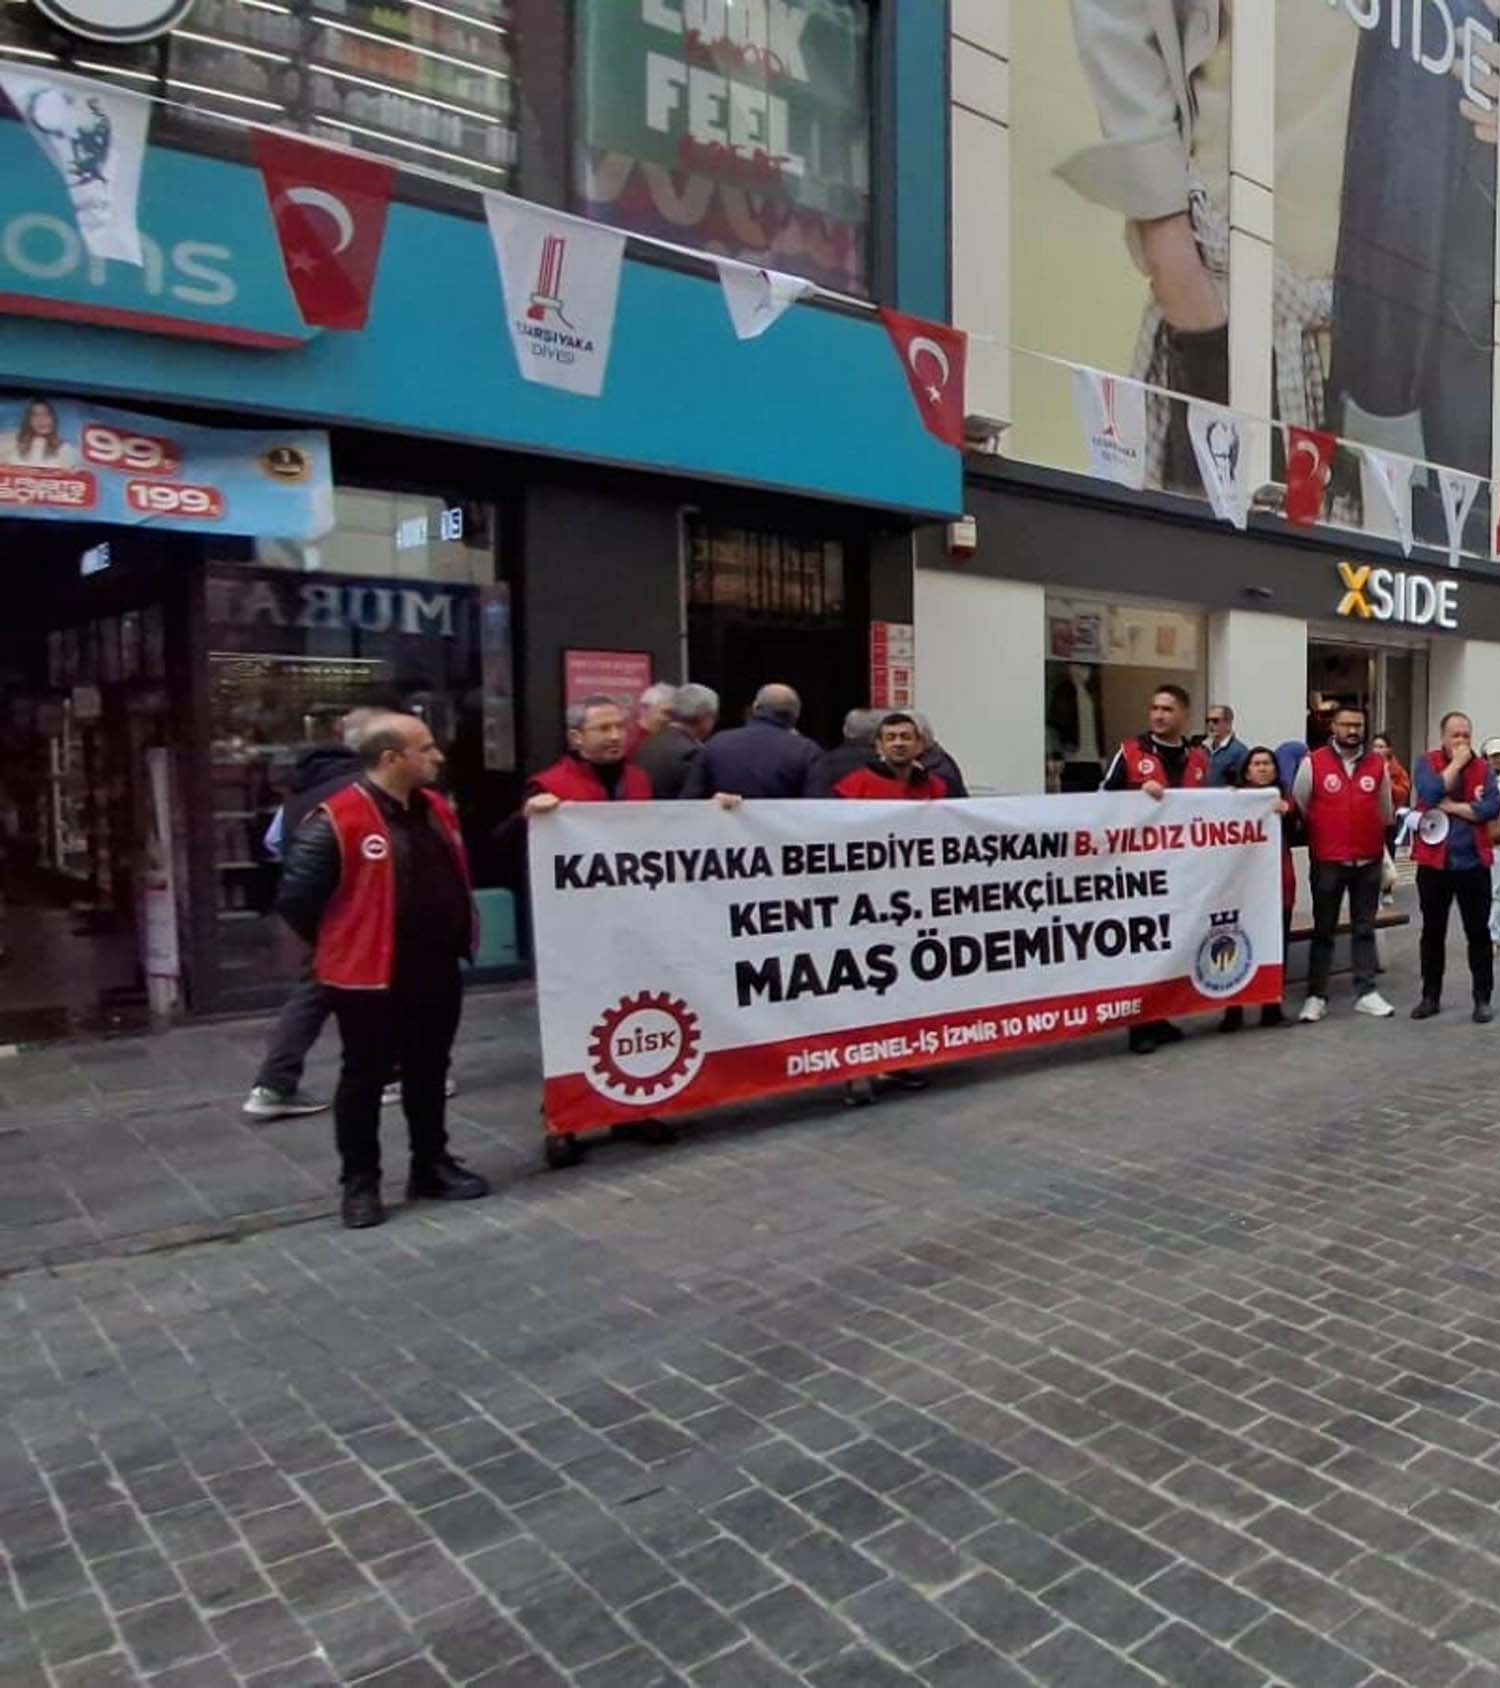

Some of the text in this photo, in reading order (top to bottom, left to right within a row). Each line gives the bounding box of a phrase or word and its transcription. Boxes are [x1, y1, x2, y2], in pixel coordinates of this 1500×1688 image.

[1336, 561, 1459, 629] XSIDE
[554, 818, 1267, 891] KARŞIYAKA BELEDİYE BAŞKANI B. YILDIZ ÜNSAL
[729, 865, 1169, 938] KENT A.Ş. EMEKÇİLERİNE
[734, 943, 899, 1008] MAAŞ
[909, 913, 1172, 983] ÖDEMİYOR!
[615, 1026, 676, 1057] DİSK
[786, 1046, 841, 1077] DİSK
[844, 1026, 940, 1065] GENEL-İŞ
[943, 1016, 998, 1049] İZMİR
[1001, 1019, 1023, 1038] 10
[1096, 997, 1144, 1023] ŞUBE
